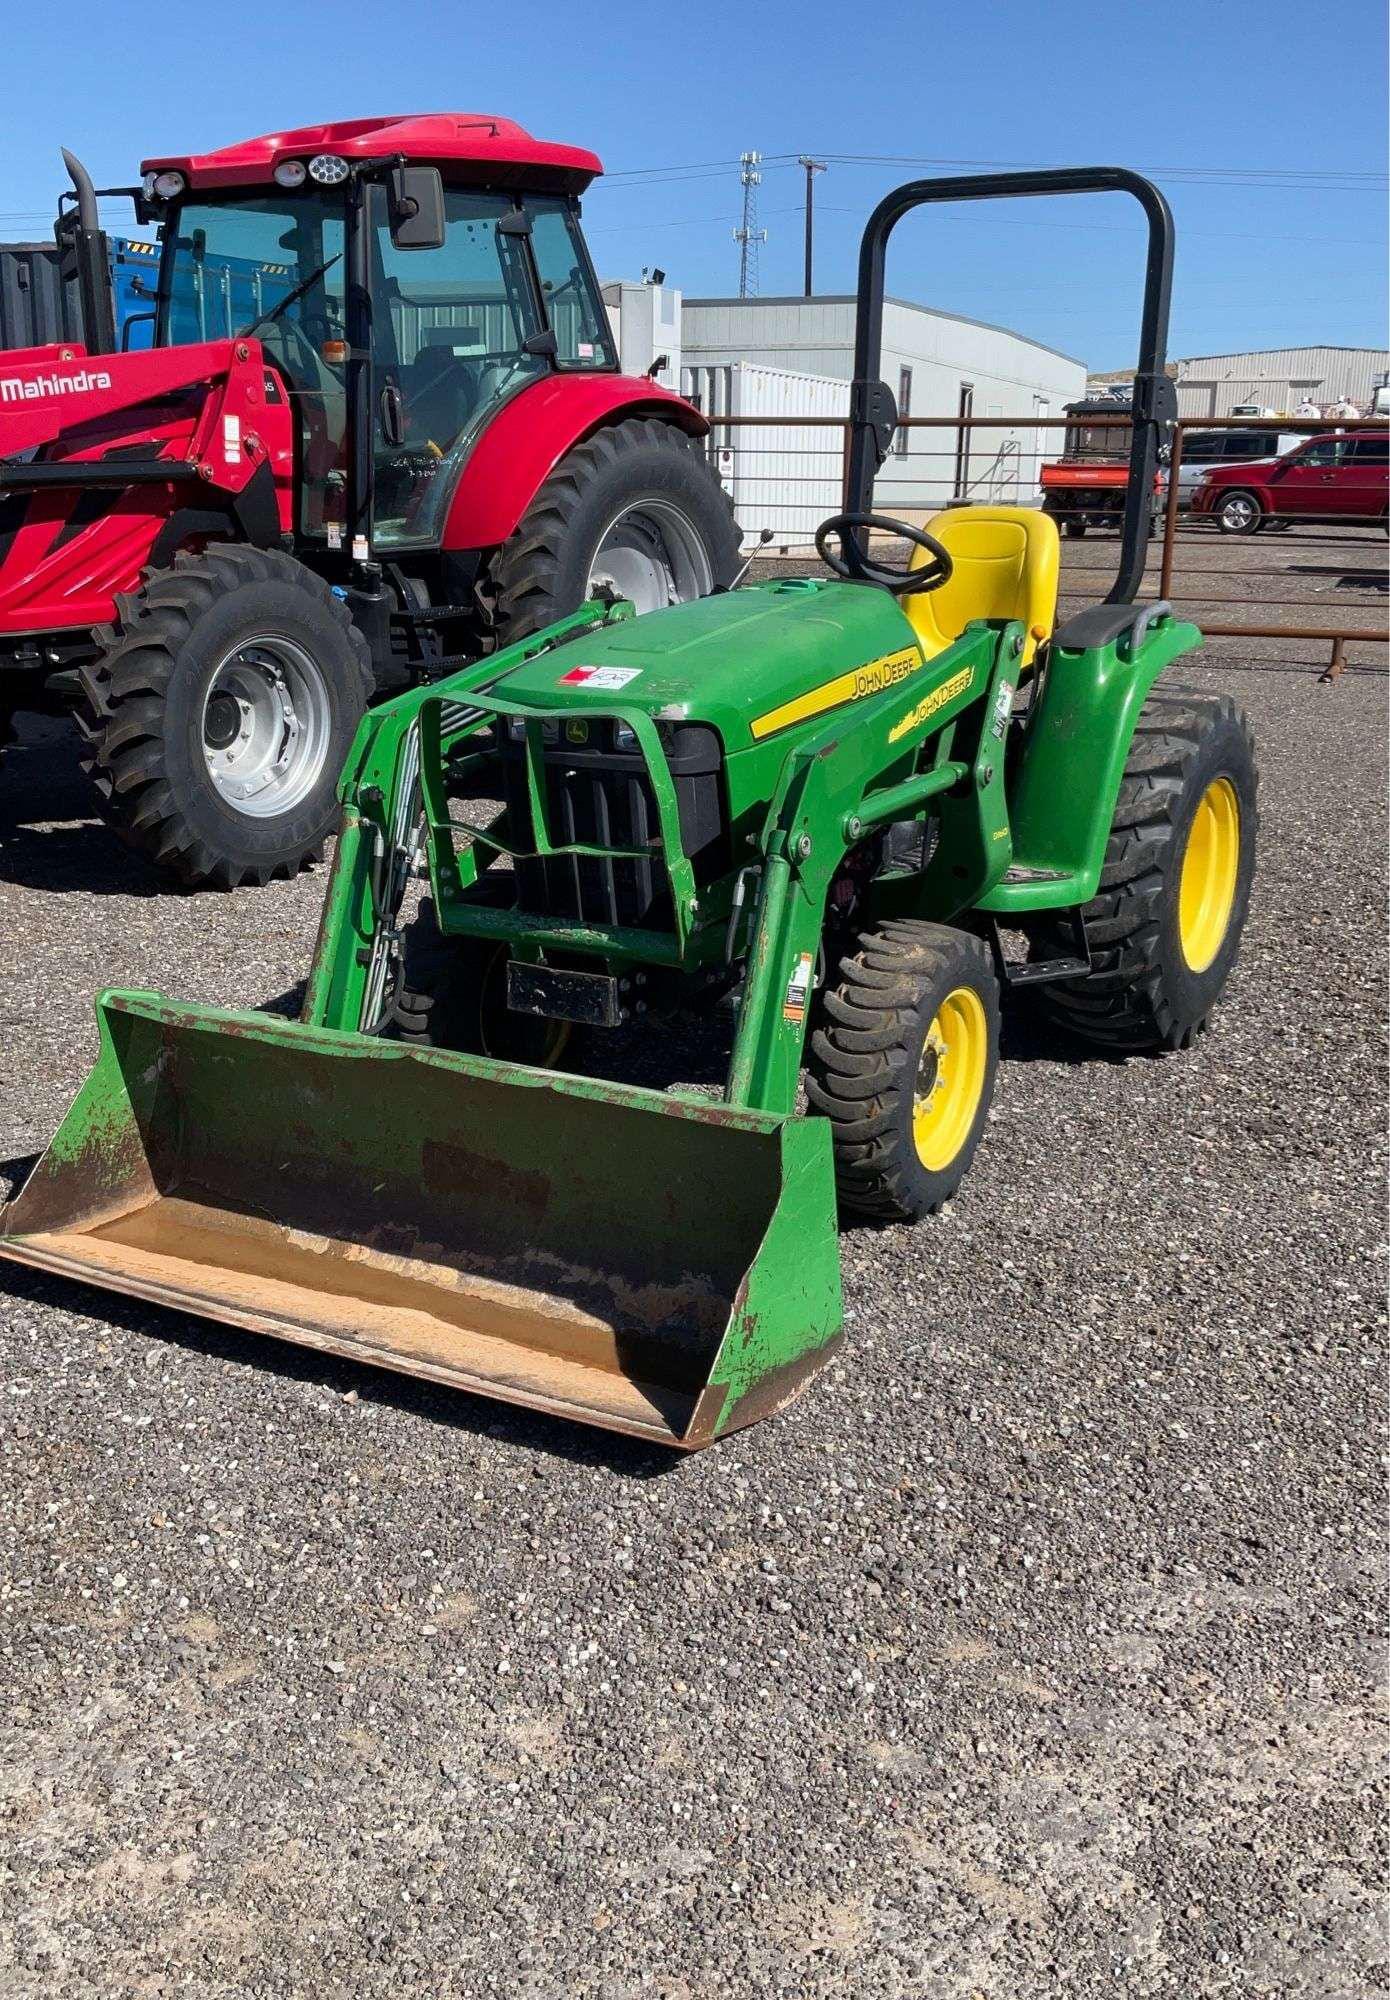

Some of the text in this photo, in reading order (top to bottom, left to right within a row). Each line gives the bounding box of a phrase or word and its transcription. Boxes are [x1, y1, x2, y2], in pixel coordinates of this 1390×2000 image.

[0, 371, 112, 402] Mahindra
[851, 657, 914, 697] JOHN DEERE
[913, 672, 970, 724] JOHN DEERE
